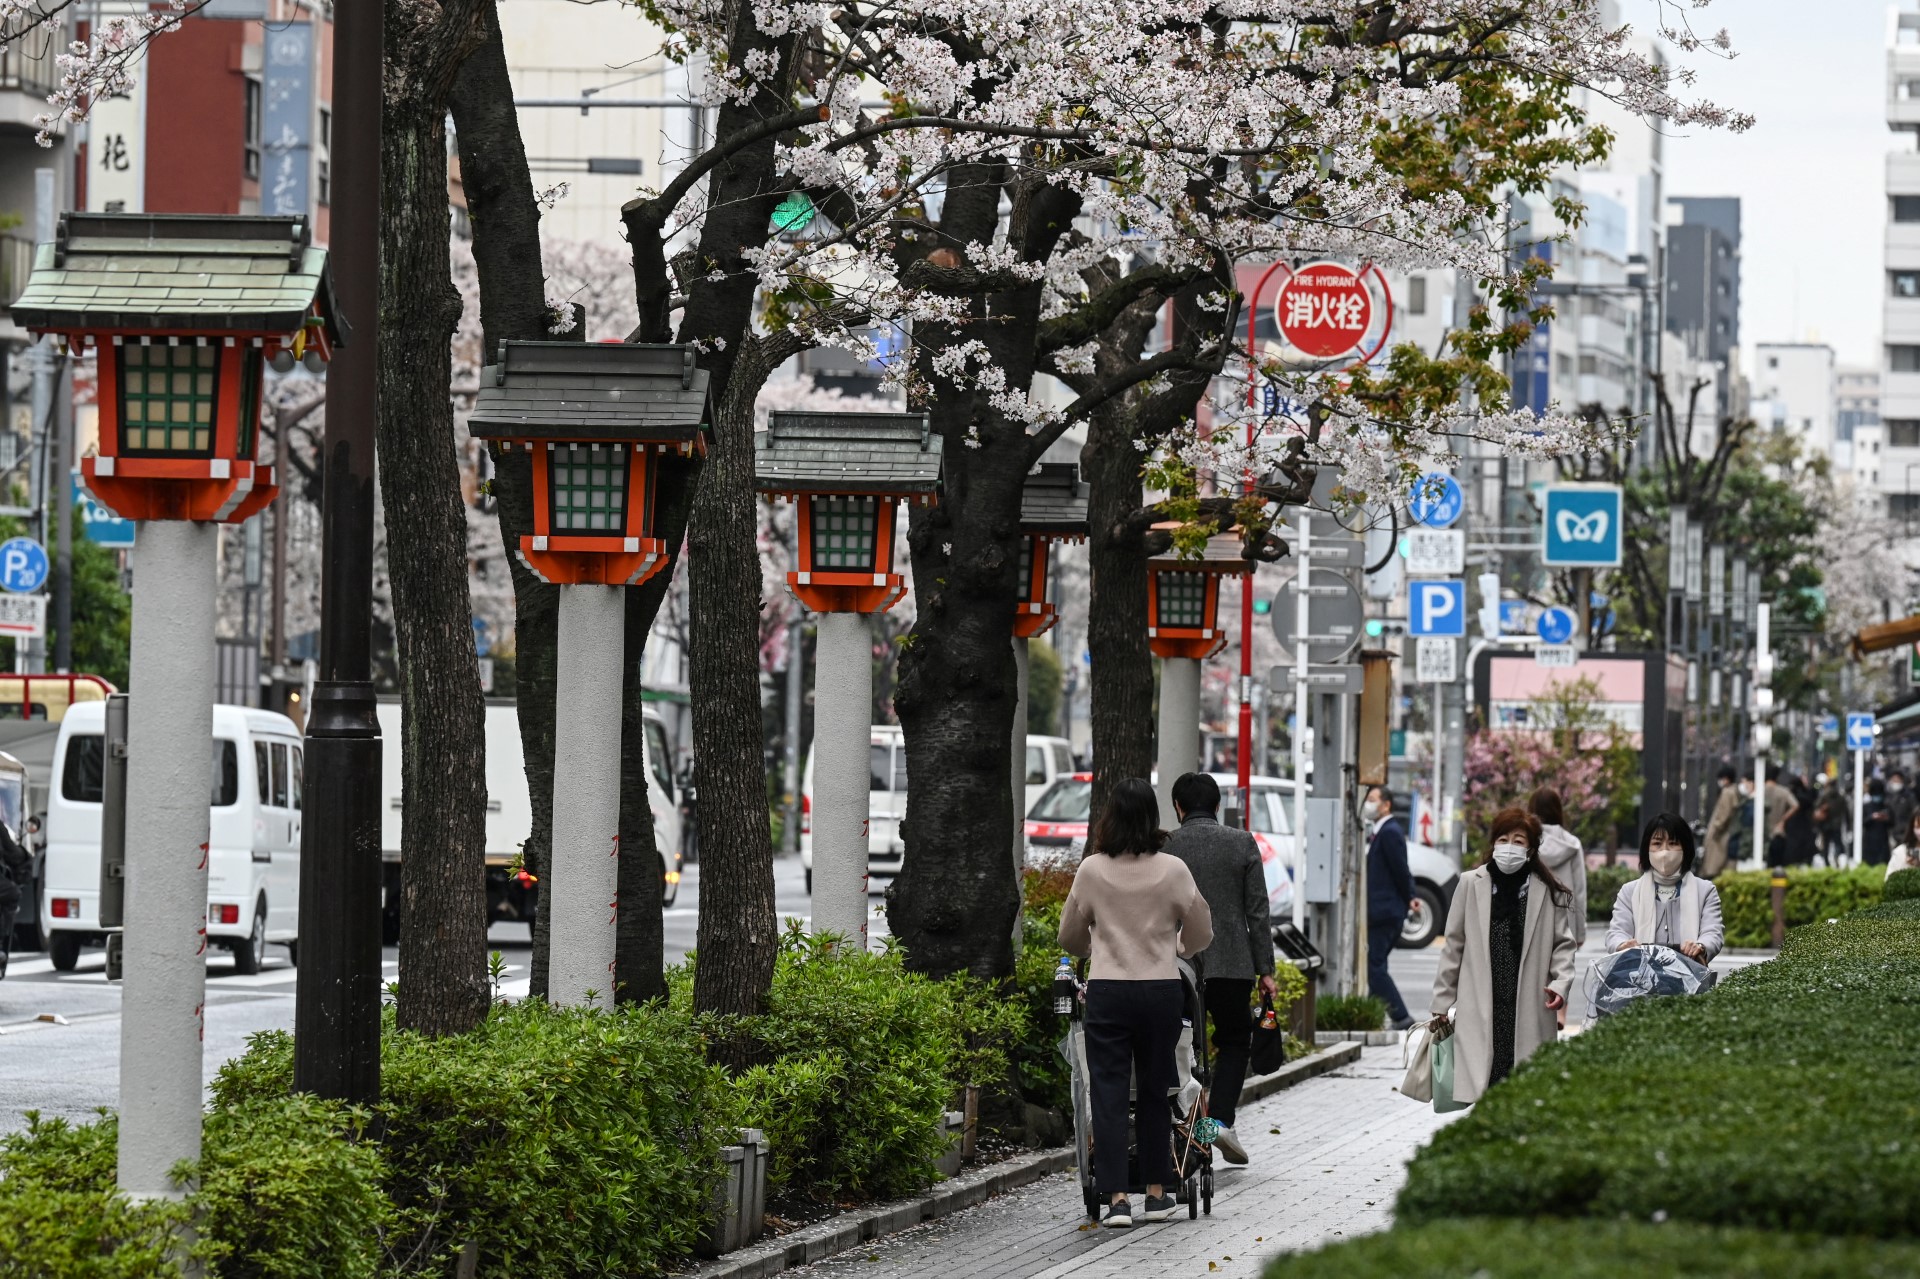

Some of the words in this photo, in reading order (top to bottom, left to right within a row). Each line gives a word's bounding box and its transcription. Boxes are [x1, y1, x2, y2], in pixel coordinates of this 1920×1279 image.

[1293, 275, 1313, 287] FIRE
[1316, 276, 1356, 287] HYDRANT
[1286, 291, 1365, 330] 消火栓
[5, 550, 28, 585] P
[1421, 585, 1455, 632] P
